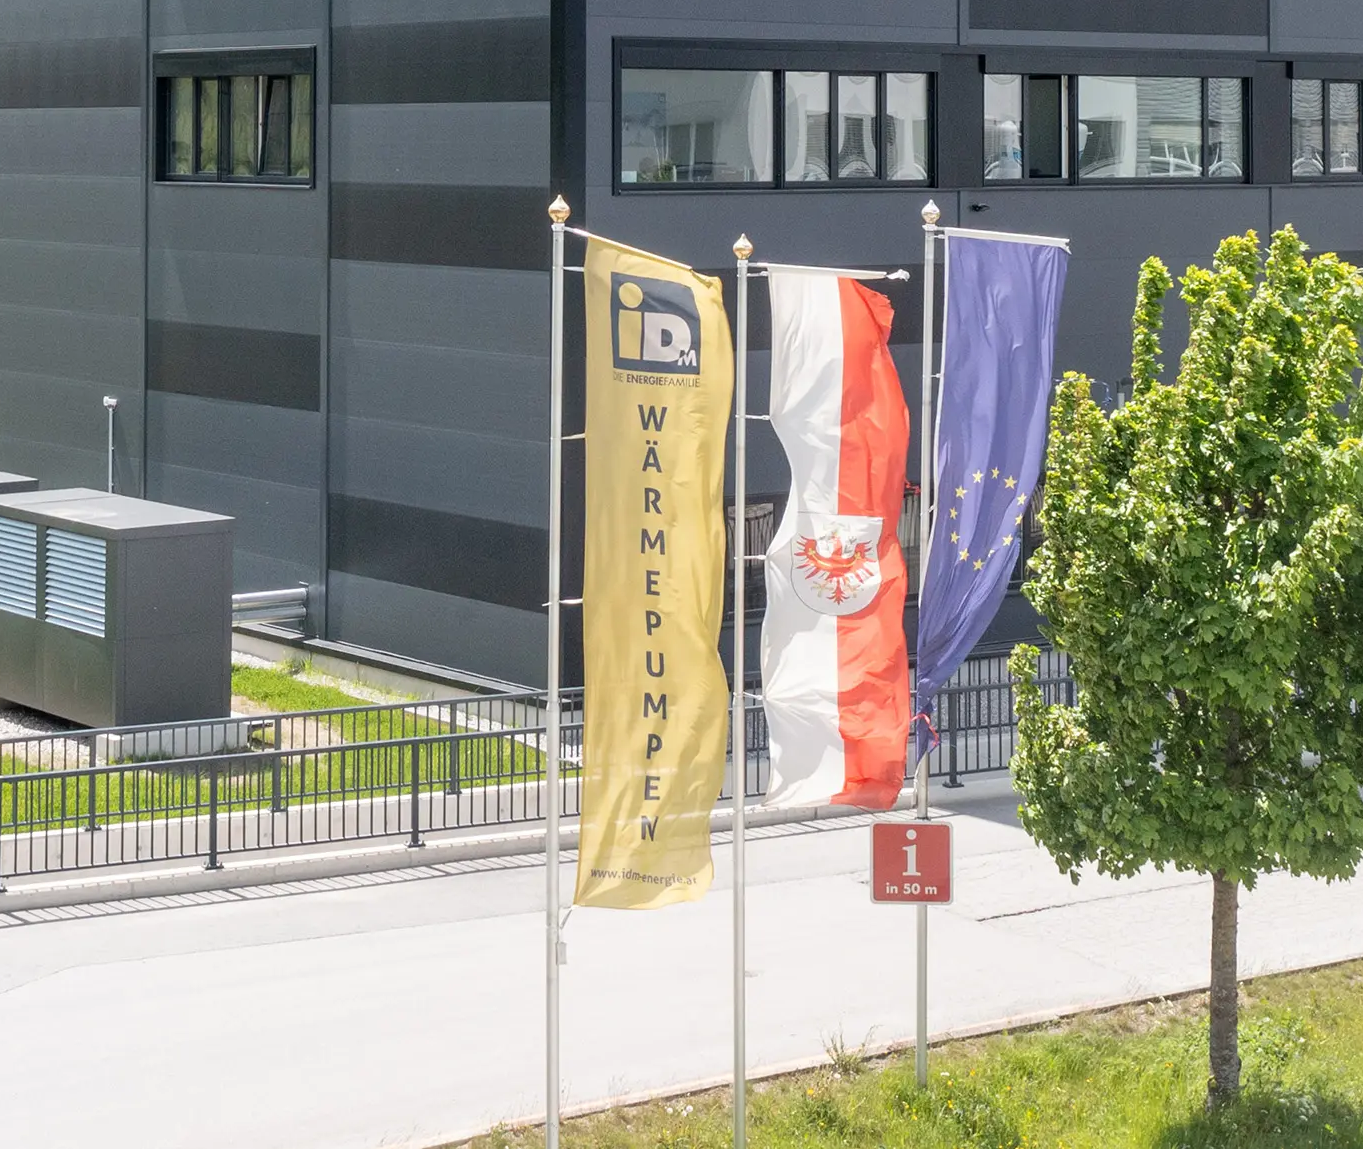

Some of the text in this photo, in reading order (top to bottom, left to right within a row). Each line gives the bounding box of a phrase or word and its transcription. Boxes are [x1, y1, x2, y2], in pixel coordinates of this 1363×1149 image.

[613, 371, 701, 388] DIE ENERGIEFAMILIE
[638, 404, 668, 842] WÄRMEPUMPEN
[590, 868, 697, 887] www.idm-energie.at
[886, 882, 937, 895] in 50 m
